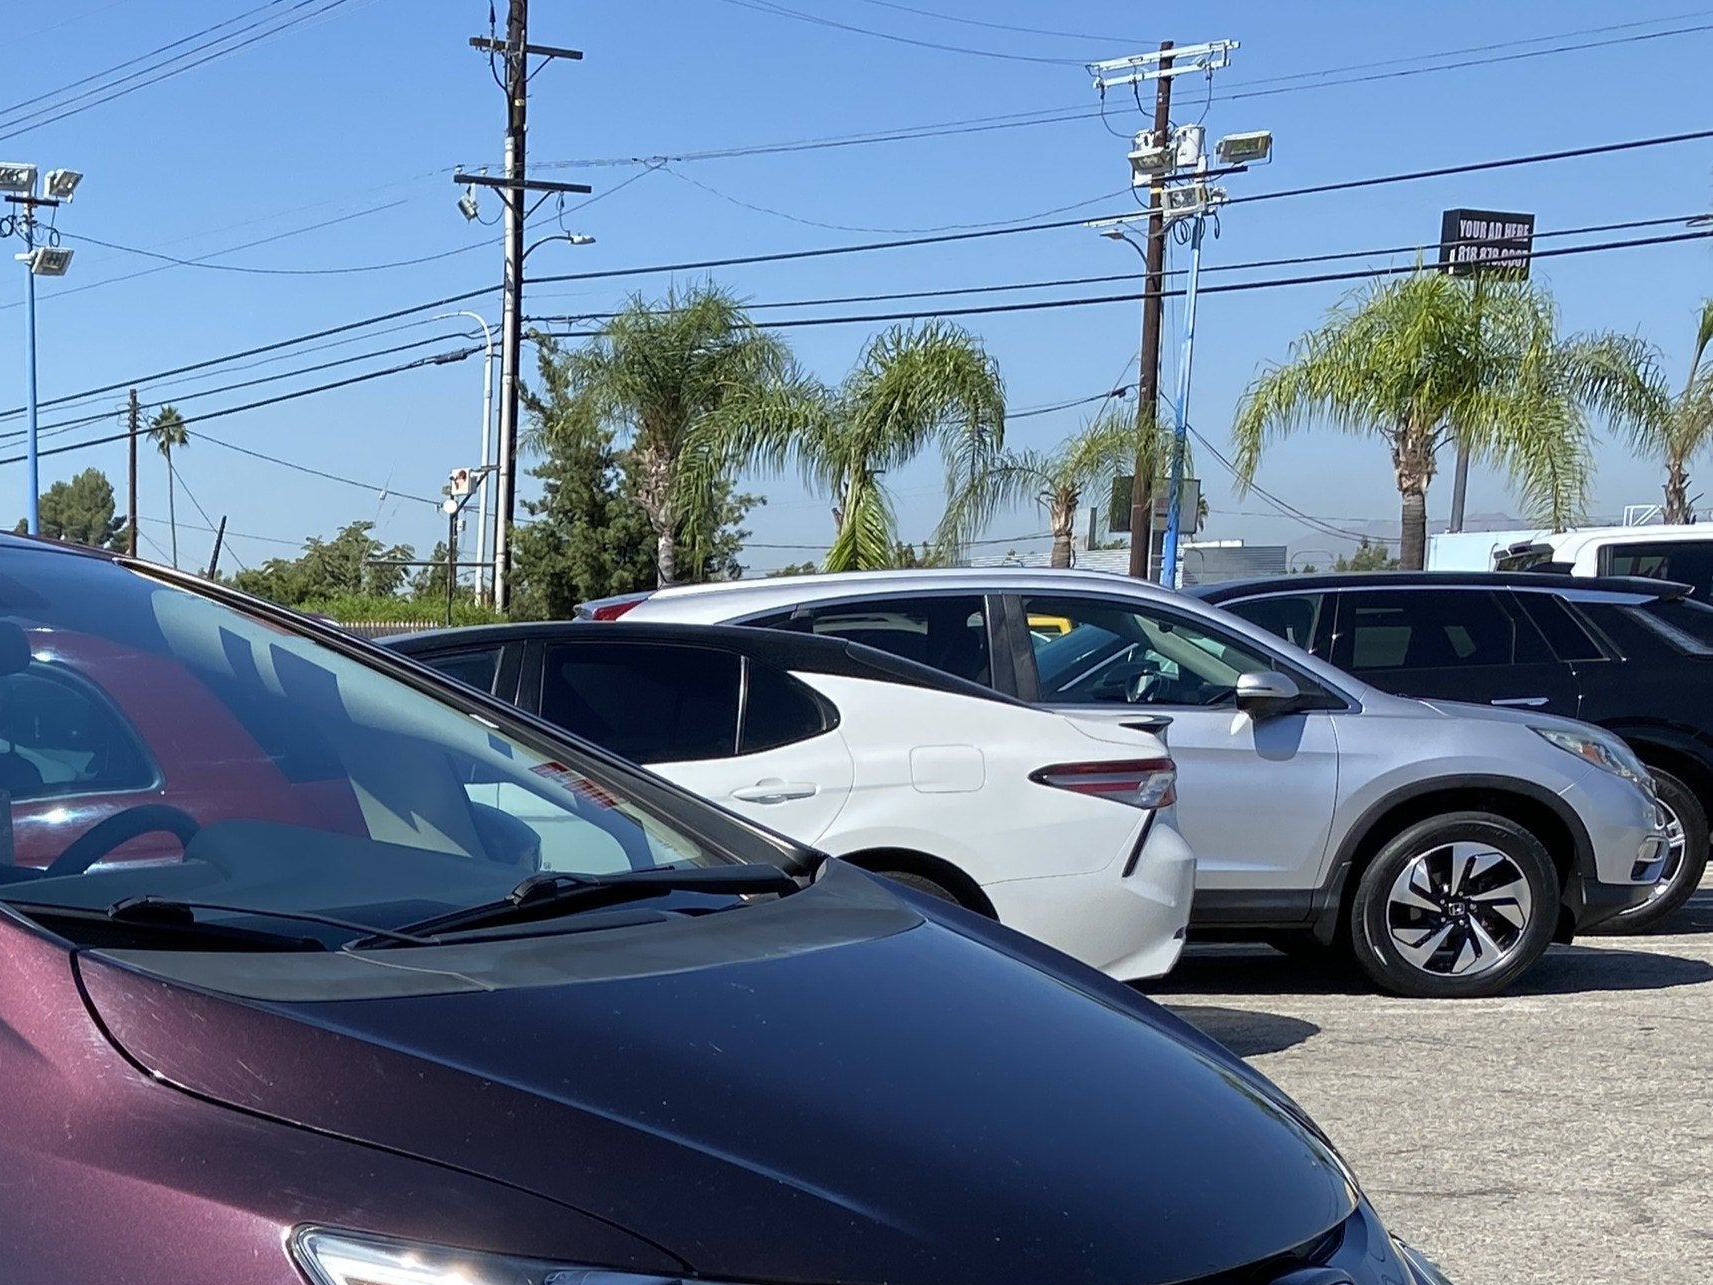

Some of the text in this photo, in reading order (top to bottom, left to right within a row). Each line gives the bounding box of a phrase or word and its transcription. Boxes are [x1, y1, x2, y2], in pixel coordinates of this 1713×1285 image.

[1460, 219, 1530, 240] YOUR AD HERE
